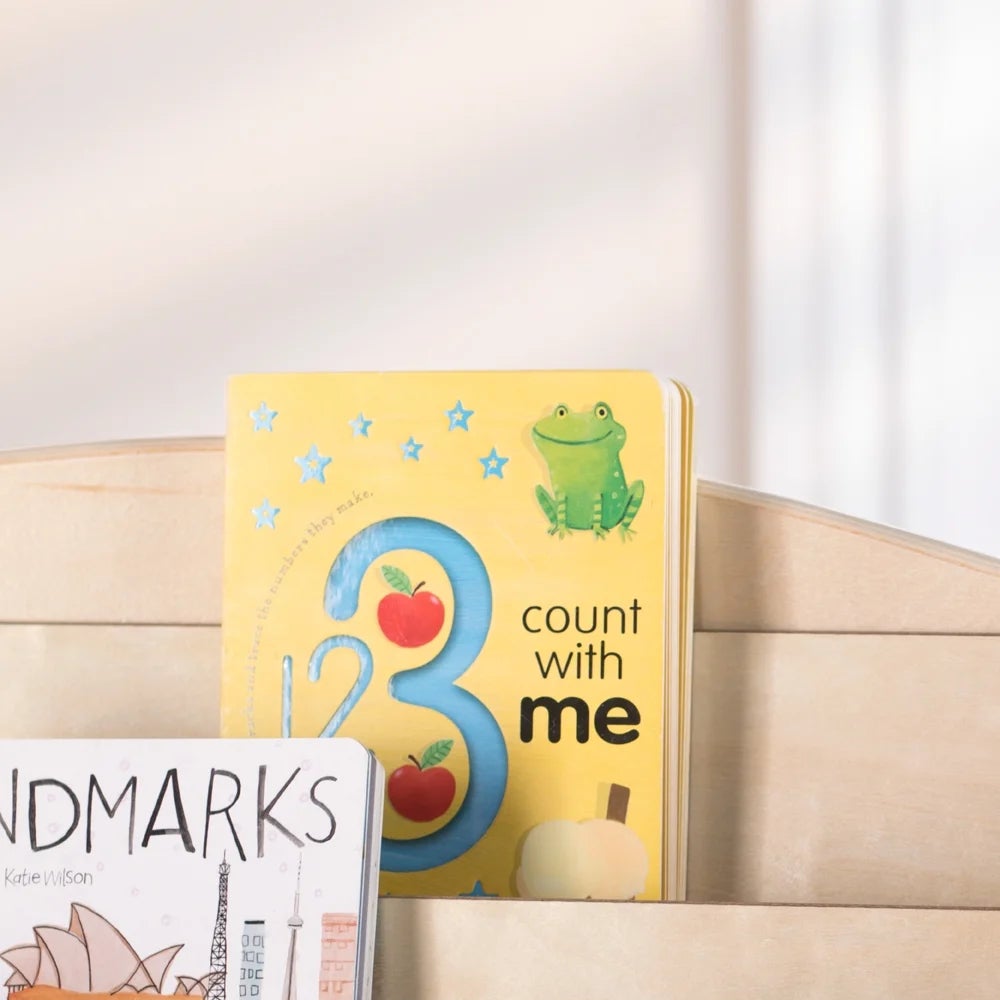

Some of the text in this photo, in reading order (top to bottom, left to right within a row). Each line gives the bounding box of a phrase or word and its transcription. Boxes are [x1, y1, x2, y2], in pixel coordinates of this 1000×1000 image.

[256, 596, 273, 621] the
[269, 537, 309, 594] numbers
[305, 515, 337, 539] they
[335, 488, 375, 514] make.
[521, 598, 642, 635] count
[534, 640, 624, 680] with
[519, 696, 642, 744] me
[4, 868, 93, 887] Katie Wilson
